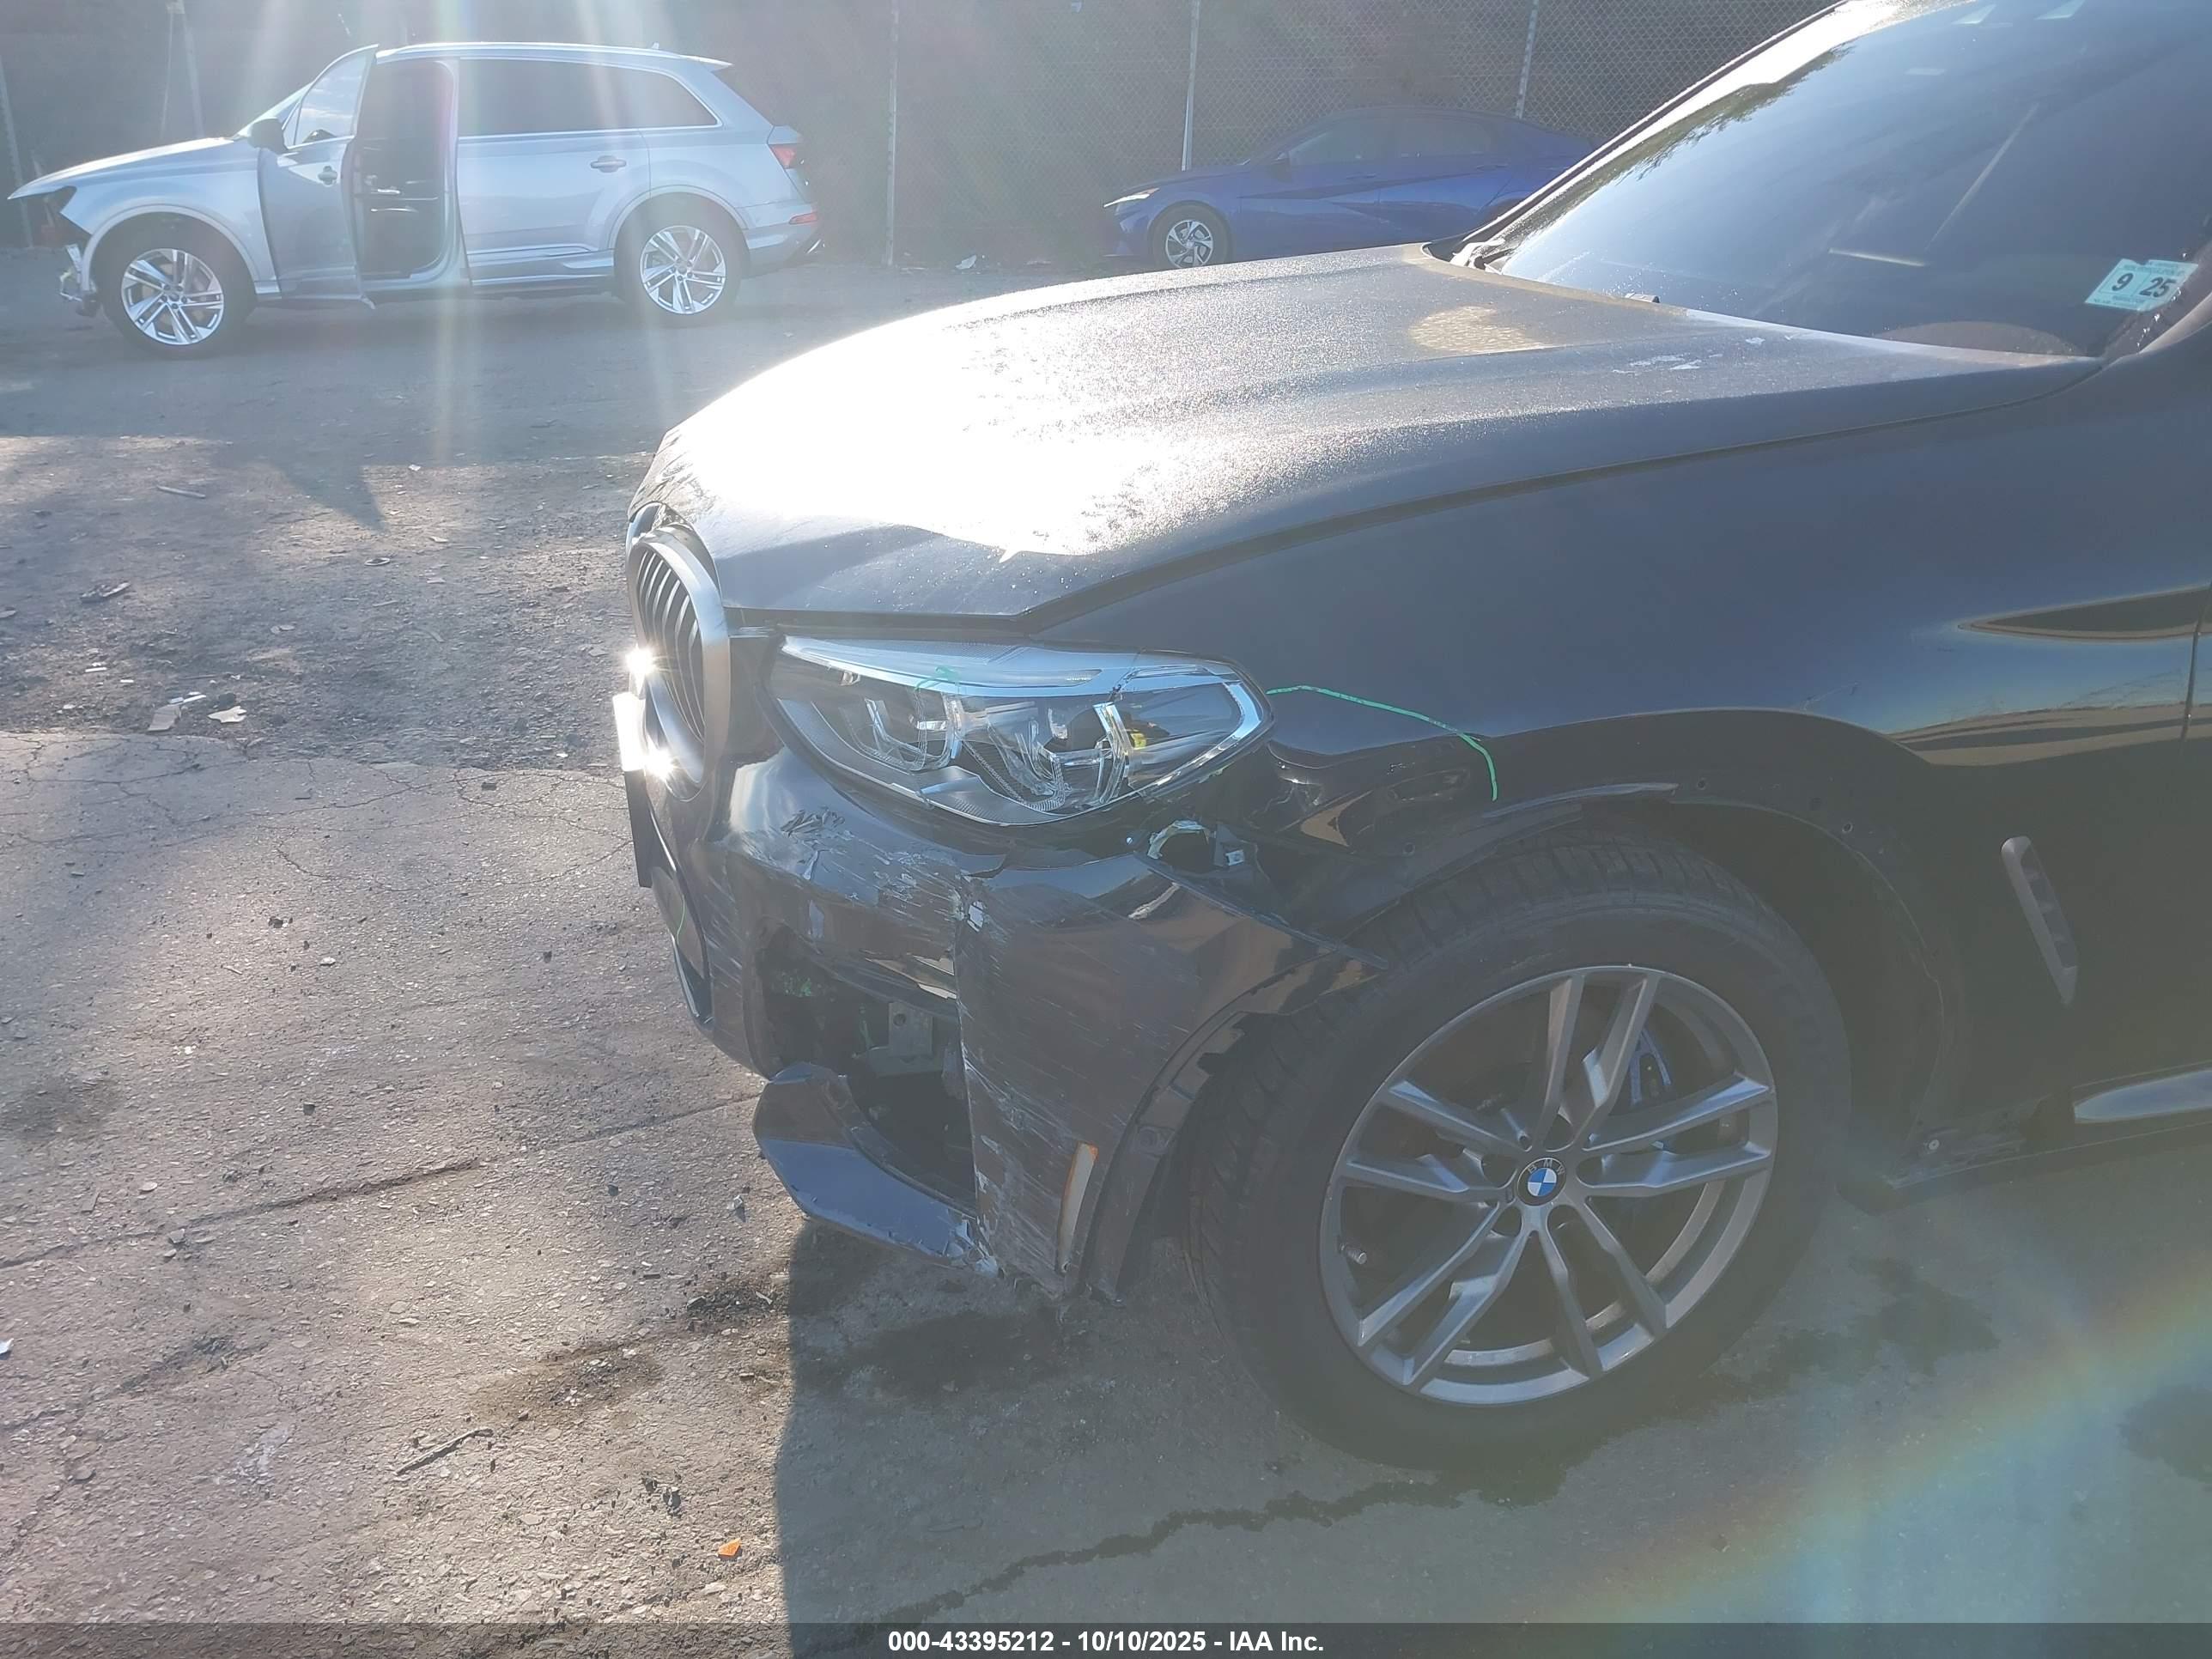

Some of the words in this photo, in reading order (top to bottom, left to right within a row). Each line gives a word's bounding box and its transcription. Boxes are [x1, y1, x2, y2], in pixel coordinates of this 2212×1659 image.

[2112, 273, 2134, 291] 9
[2139, 276, 2177, 297] 25
[1528, 1159, 1565, 1175] BMW
